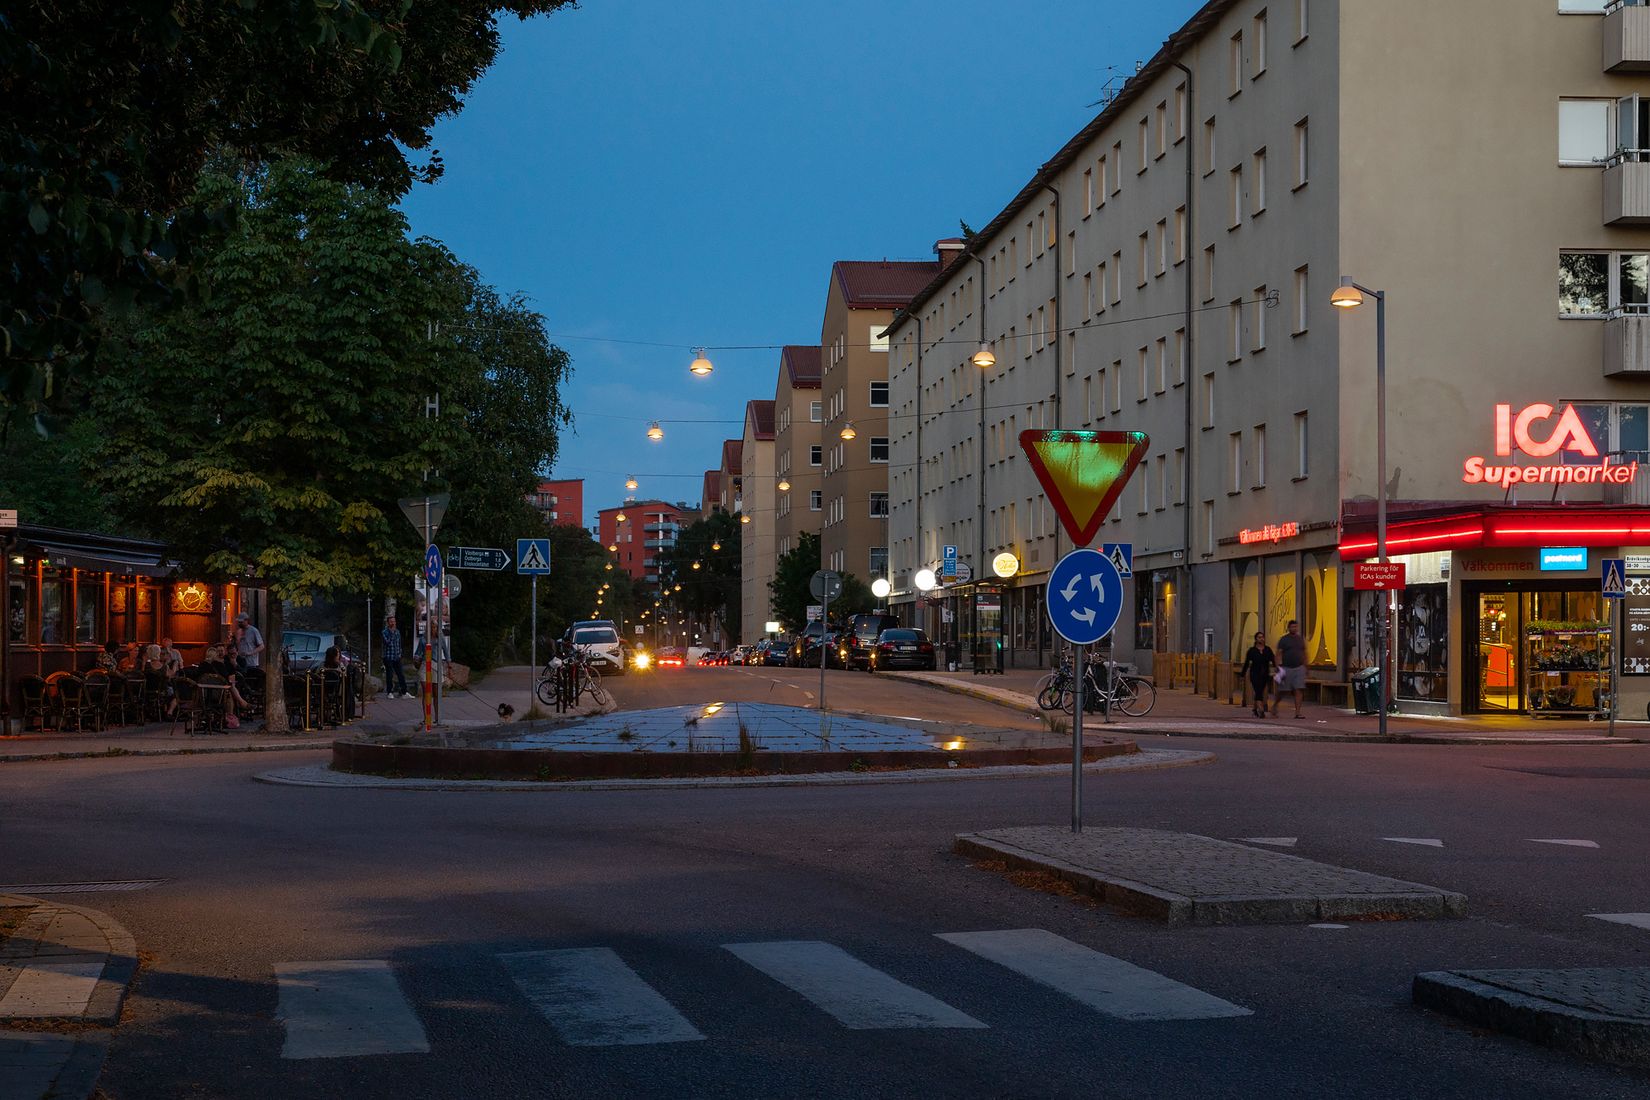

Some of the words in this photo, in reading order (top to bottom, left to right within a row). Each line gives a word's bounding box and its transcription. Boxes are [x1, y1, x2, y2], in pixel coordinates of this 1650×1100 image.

[1496, 403, 1599, 457] ICA
[1463, 456, 1638, 489] Supermarket
[946, 547, 955, 558] P
[1544, 554, 1583, 564] postnord
[1360, 565, 1389, 573] Parkering
[1461, 560, 1534, 572] Välkommen
